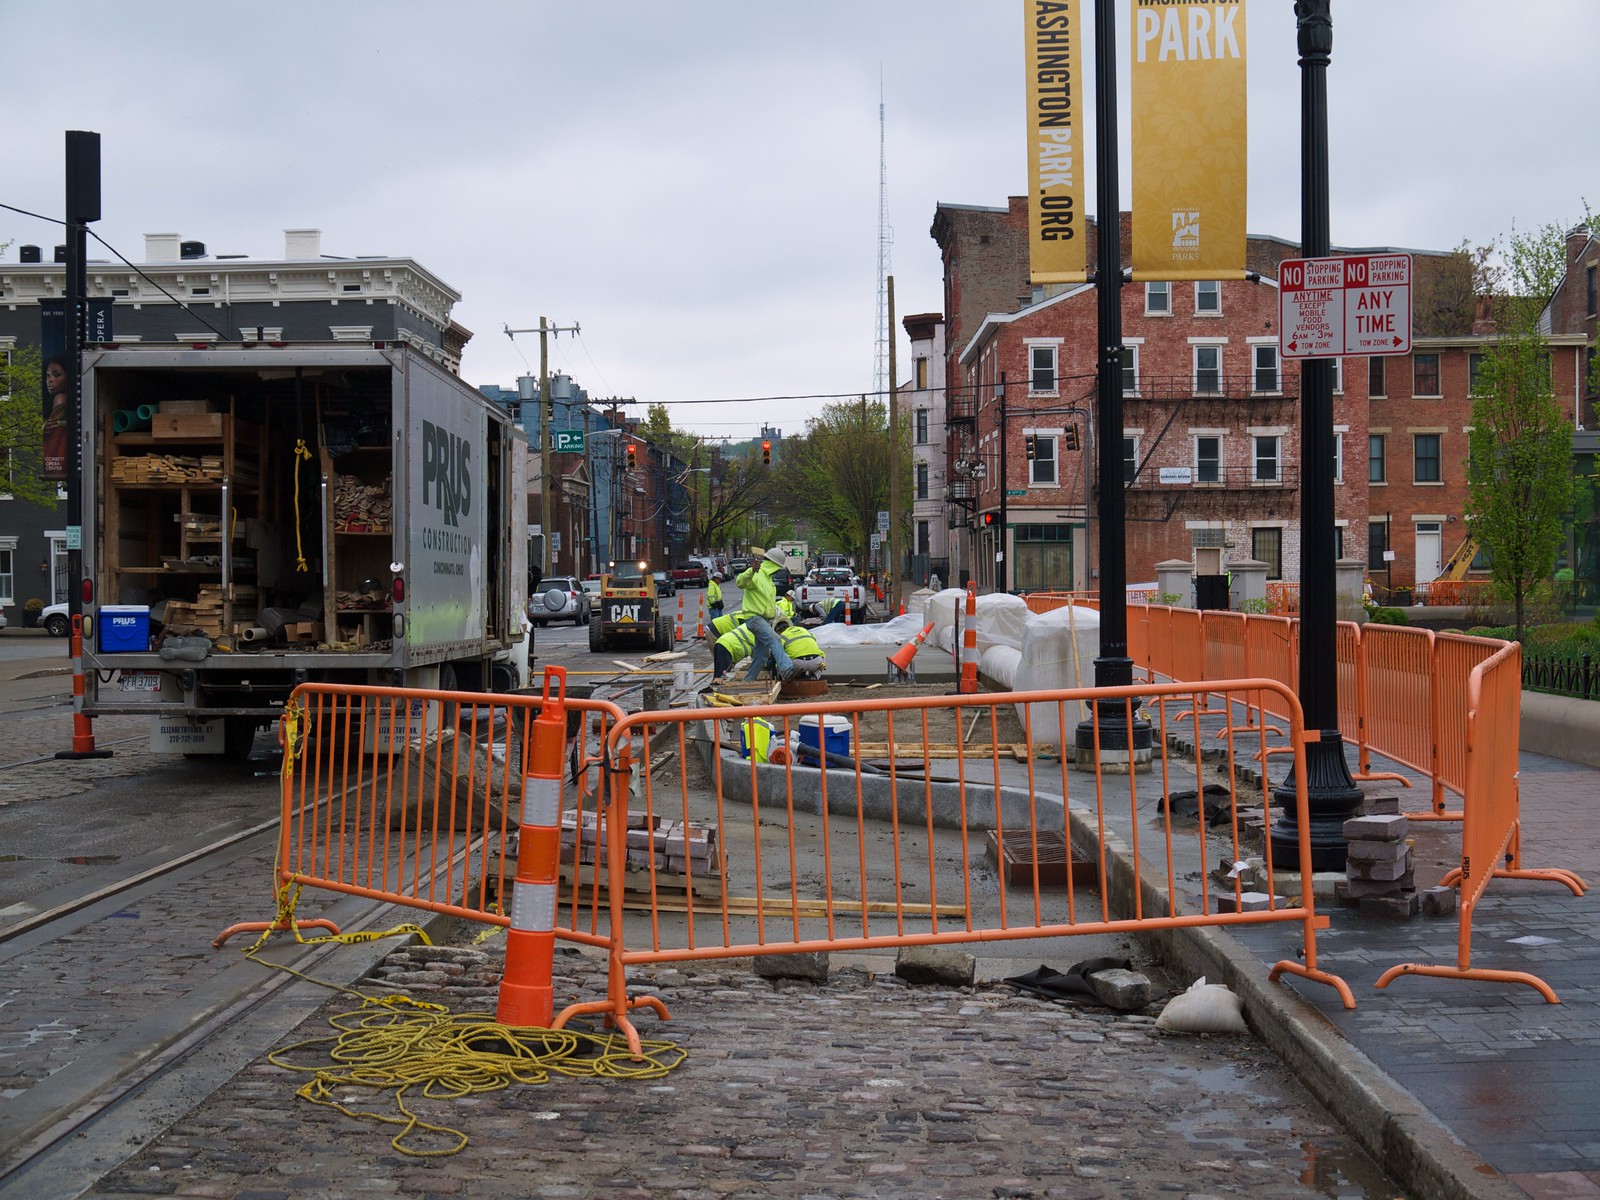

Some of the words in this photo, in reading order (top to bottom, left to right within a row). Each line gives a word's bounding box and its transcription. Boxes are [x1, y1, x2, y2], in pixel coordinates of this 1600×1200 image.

[1137, 6, 1240, 63] PARK
[1036, 0, 1074, 241] ASHINGTONPARK.ORG
[1172, 253, 1200, 261] PARKS
[1306, 263, 1342, 275] STOPPING
[1370, 259, 1406, 271] STOPPING
[1283, 267, 1302, 286] NO
[1347, 263, 1366, 283] NO
[1372, 271, 1404, 282] PARKING
[1308, 274, 1340, 286] PARKING
[1293, 290, 1333, 302] ANYTIME
[1357, 290, 1394, 310] ANY
[1299, 302, 1326, 310] EXCEPT
[1299, 309, 1326, 317] MOBILE
[97, 310, 105, 342] OPERA
[1302, 316, 1323, 324] FOOD
[1355, 314, 1396, 334] TIME
[1296, 323, 1330, 331] VENDORS
[1301, 342, 1314, 350] TOW
[1314, 341, 1331, 349] ZONE
[1359, 339, 1372, 347] TOW
[1373, 338, 1389, 346] ZONE
[422, 419, 471, 527] PRUS
[422, 526, 472, 556] CONSTRUCTION
[871, 541, 880, 549] 25
[784, 548, 804, 558] edEx
[610, 604, 641, 623] CAT
[112, 617, 136, 625] PRUS
